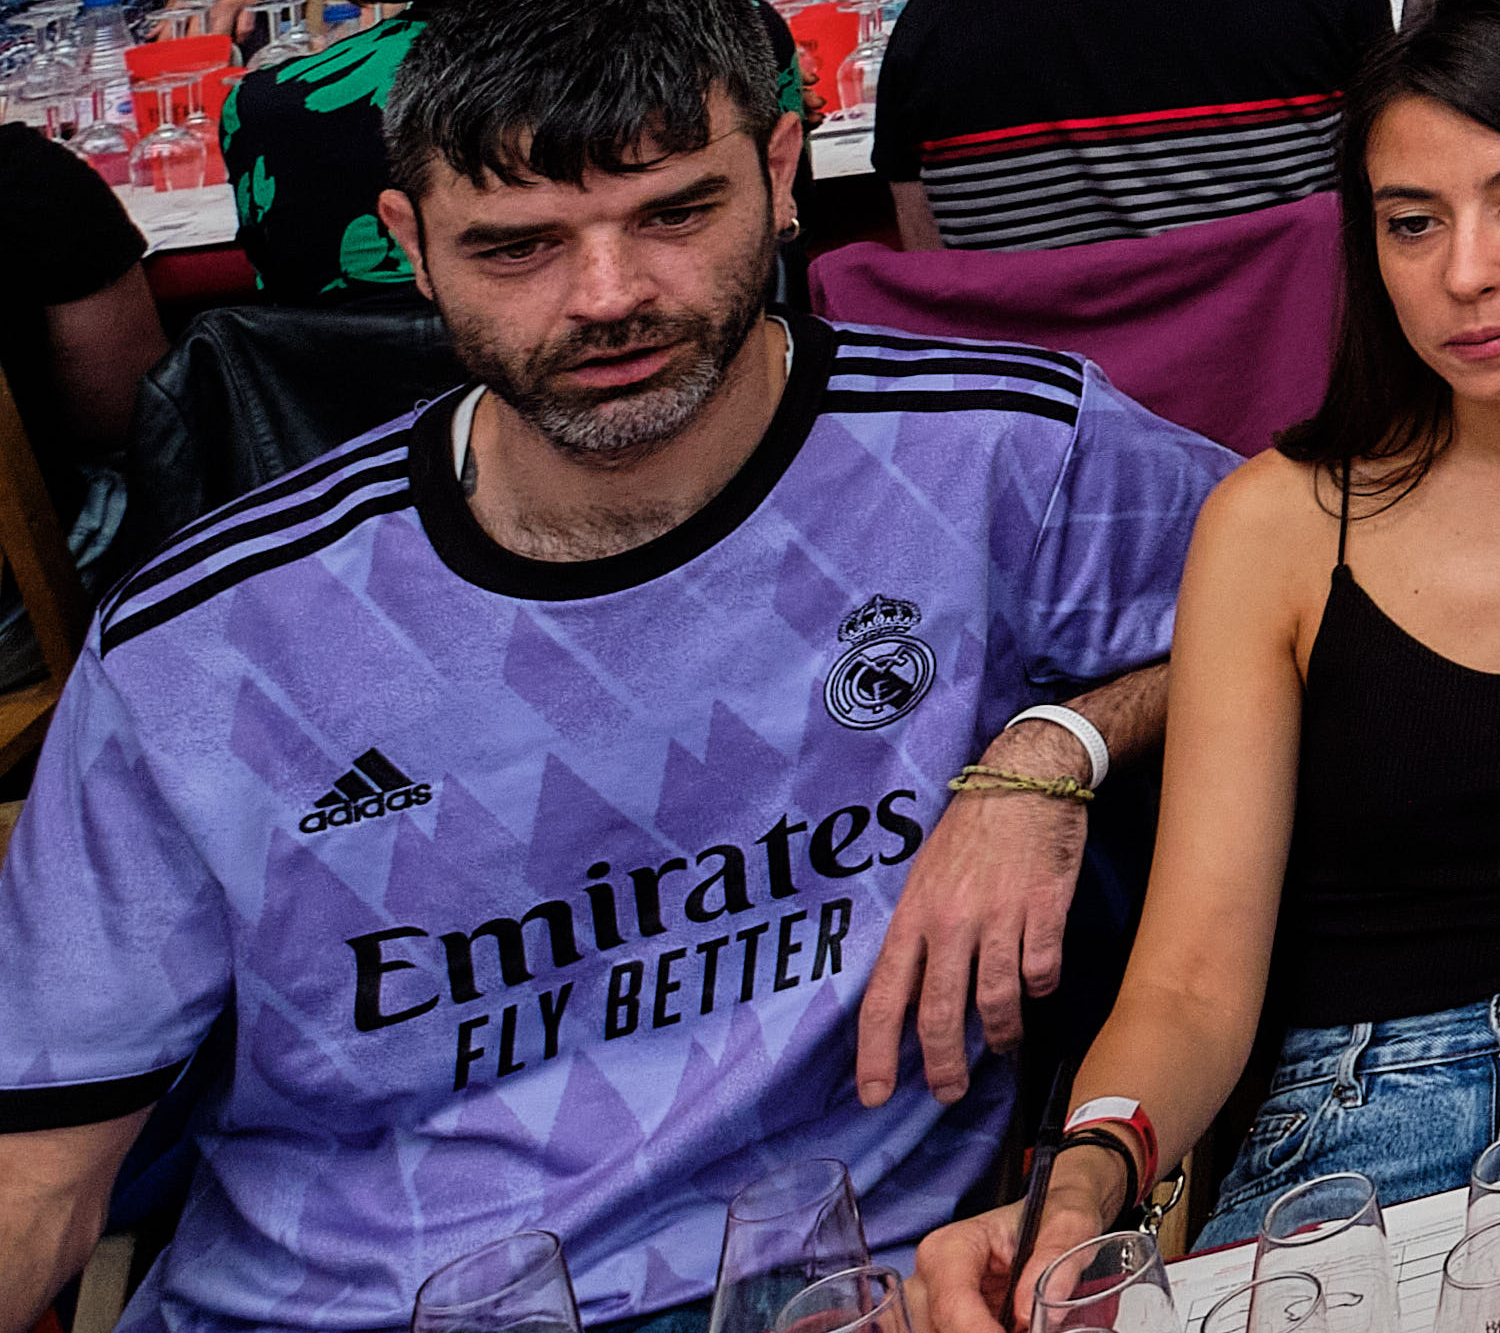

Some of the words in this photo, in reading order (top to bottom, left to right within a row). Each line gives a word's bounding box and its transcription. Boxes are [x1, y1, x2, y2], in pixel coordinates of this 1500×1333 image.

[298, 777, 433, 836] adidas
[345, 787, 925, 1034] Emirates
[603, 896, 855, 1042] BETTER
[452, 979, 575, 1092] FLY
